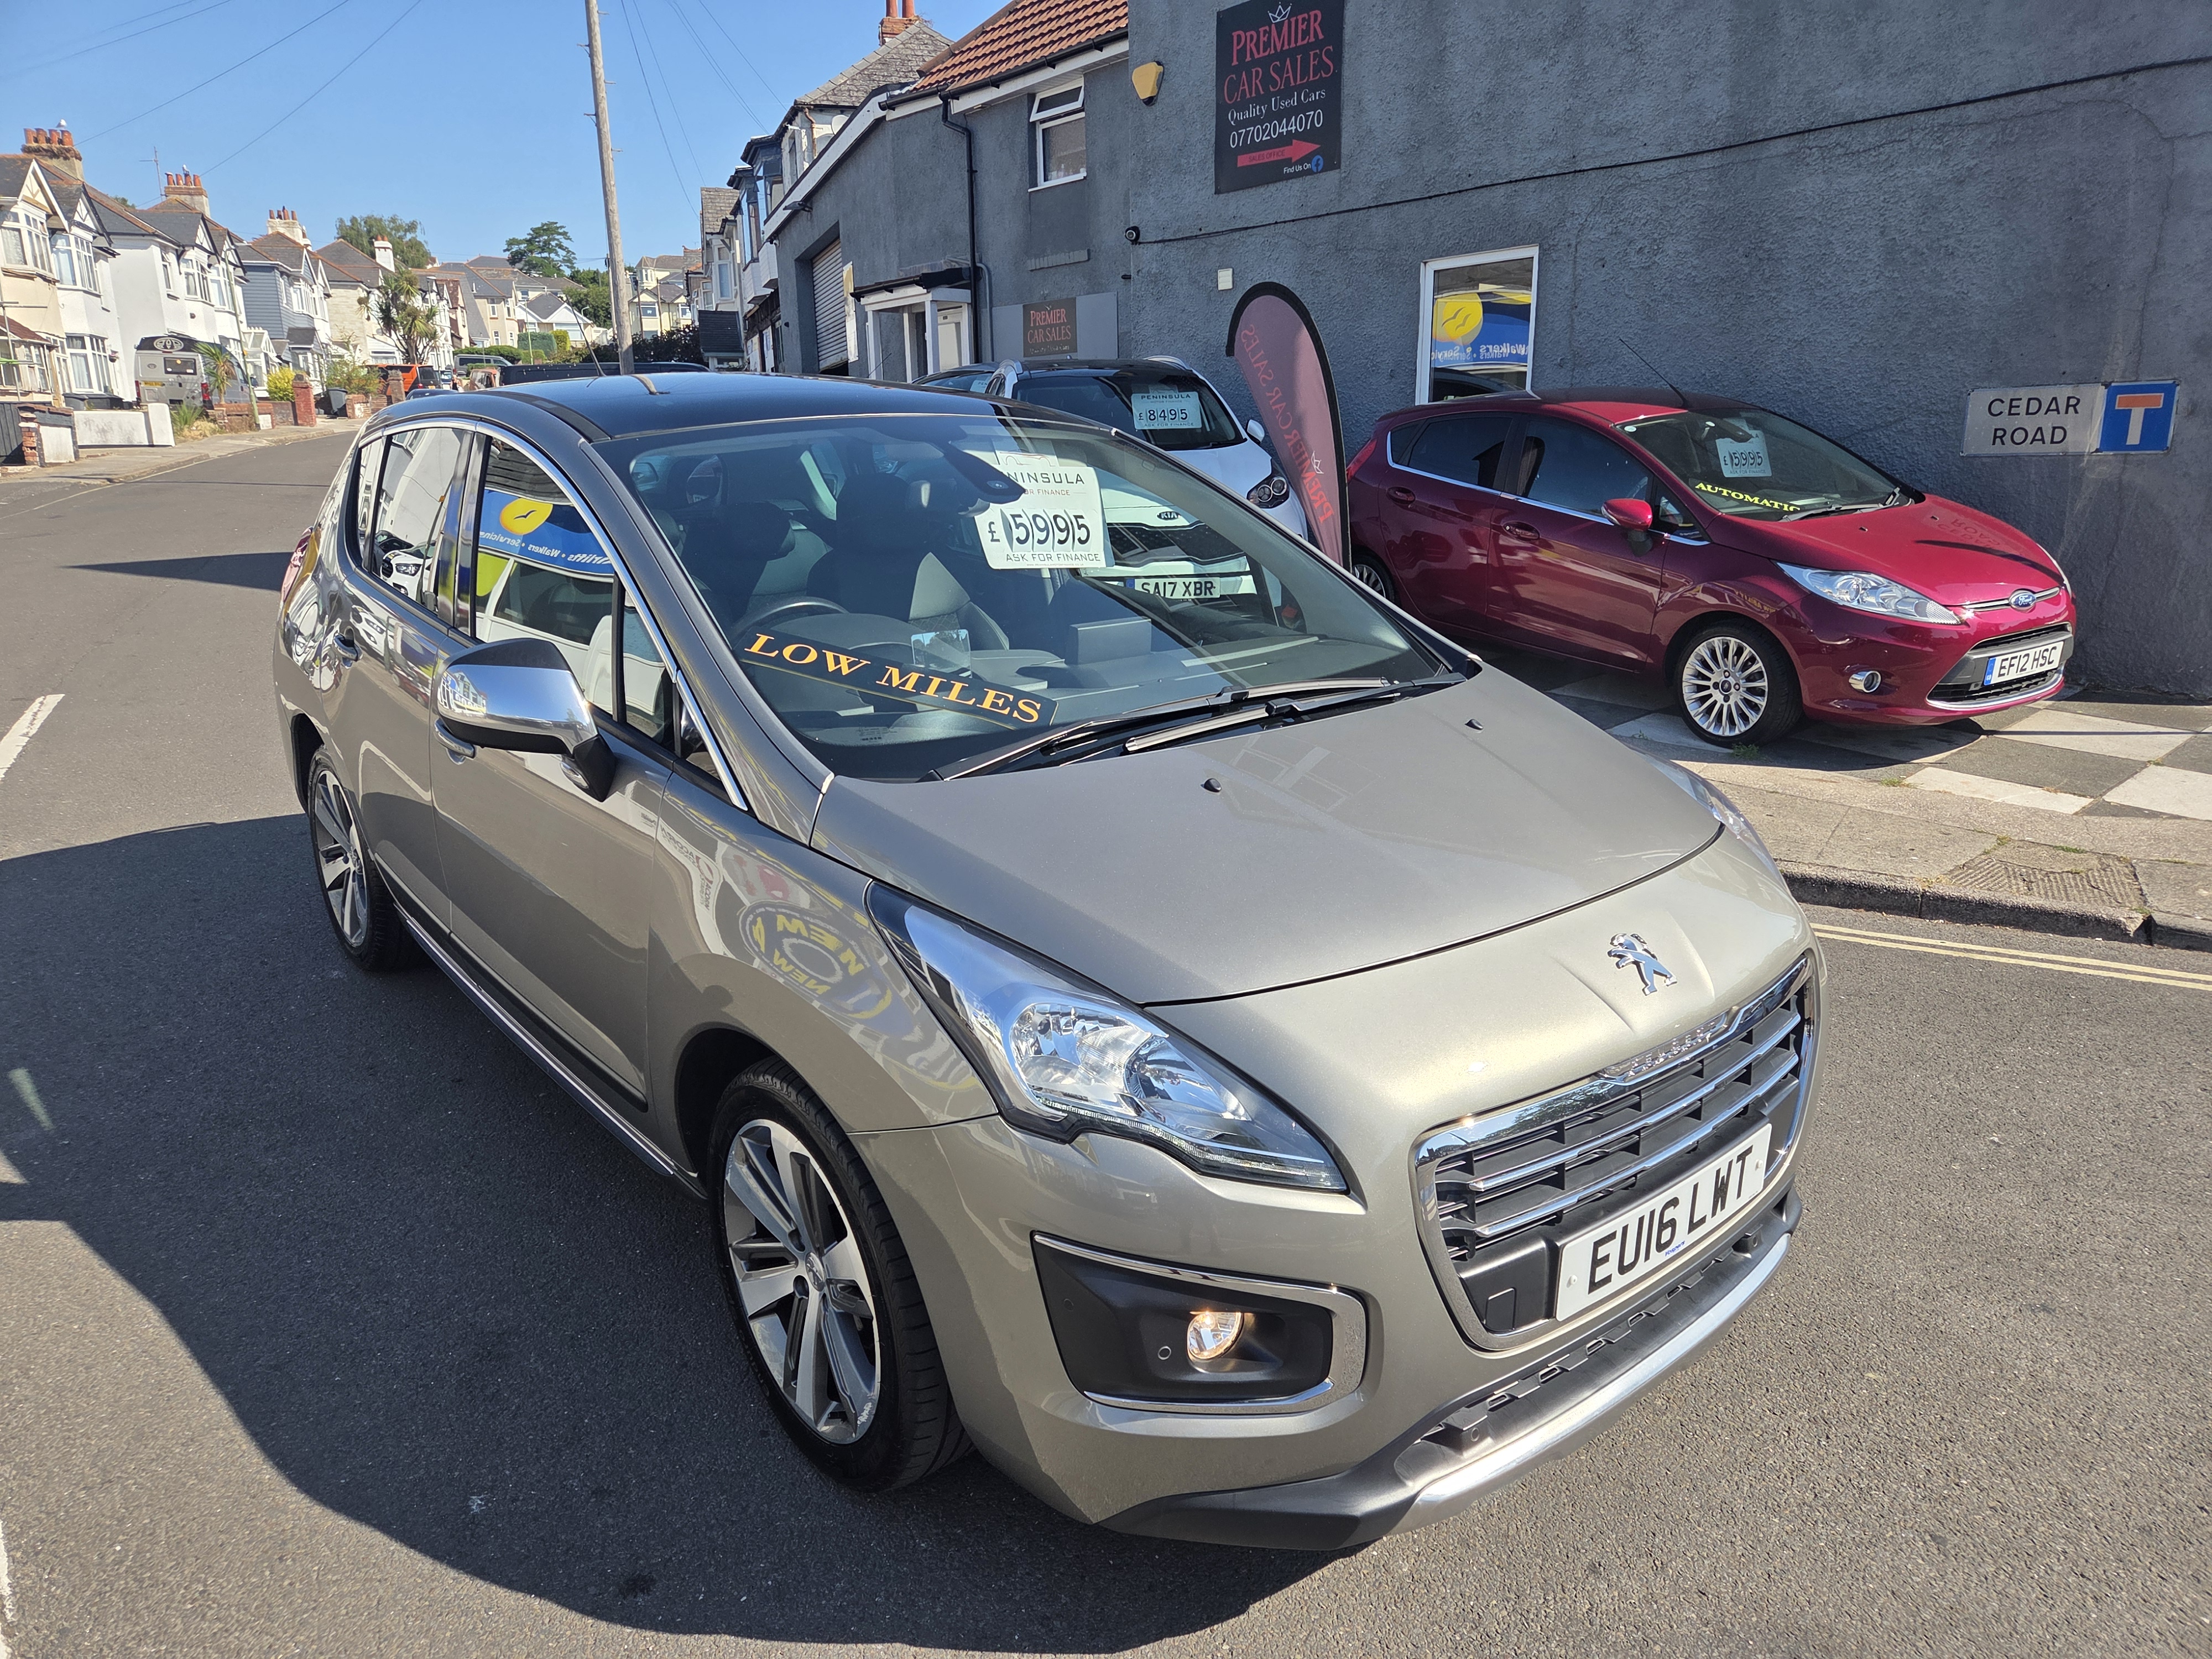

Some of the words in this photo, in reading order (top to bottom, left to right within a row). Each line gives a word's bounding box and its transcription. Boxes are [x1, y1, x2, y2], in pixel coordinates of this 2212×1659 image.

[1232, 10, 1324, 66] PREMIER
[1224, 67, 1264, 104] CAR
[1269, 45, 1334, 92] SALES
[1228, 104, 1267, 126] Quality
[1272, 92, 1297, 111] Used
[1301, 88, 1326, 103] Cars
[1230, 109, 1323, 148] 07702044070
[1266, 150, 1285, 159] OFFICE
[1030, 309, 1067, 326] PREMIER
[1027, 329, 1044, 343] CAR
[1046, 325, 1071, 341] SALES
[1988, 396, 2080, 417] CEDAR
[1991, 426, 2067, 446] ROAD
[1006, 472, 1084, 484] NINSULA
[1006, 554, 1028, 562] ASK
[1032, 554, 1053, 562] FOR
[1141, 582, 1177, 597] SA17
[1182, 581, 1214, 597] XBR
[2018, 595, 2033, 606] Ford
[1997, 653, 2030, 677] EF12
[2031, 646, 2057, 670] HSC
[744, 633, 870, 676] LOW
[876, 666, 1041, 723] MILES
[1588, 1196, 1680, 1295] EU16
[1687, 1145, 1754, 1235] LWT
